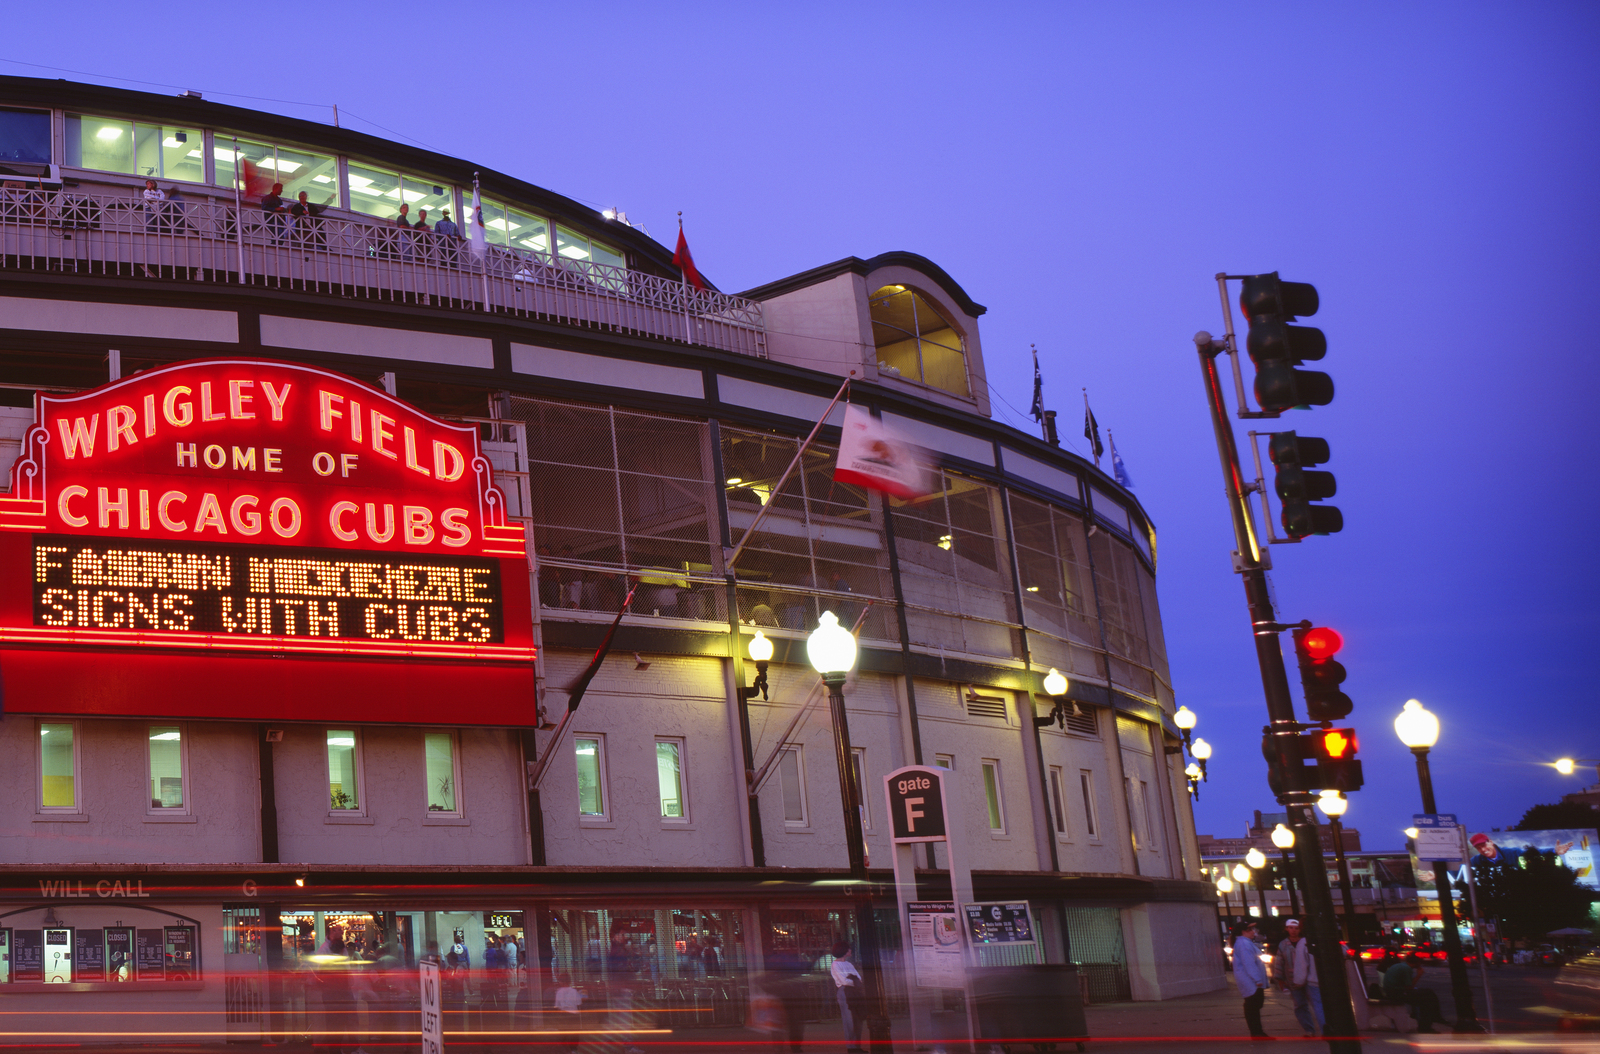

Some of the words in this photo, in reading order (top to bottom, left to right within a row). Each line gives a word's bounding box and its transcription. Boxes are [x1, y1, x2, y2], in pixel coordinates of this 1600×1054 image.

[56, 379, 292, 459] WRIGLEY
[319, 389, 466, 483] FIELD
[176, 442, 283, 473] HOME
[312, 451, 359, 478] OF
[57, 484, 303, 539] CHICAGO
[329, 500, 472, 547] CUBS
[40, 588, 194, 631] SIGNS
[222, 596, 340, 637] WITH
[364, 602, 492, 643] CUBS
[898, 776, 931, 795] gate
[904, 797, 925, 833] F
[39, 880, 90, 898] WILL
[96, 879, 150, 898] CALL
[242, 879, 258, 896] G
[425, 978, 434, 1006] NO
[424, 1010, 437, 1035] LEFT
[424, 1038, 439, 1054] TURN
